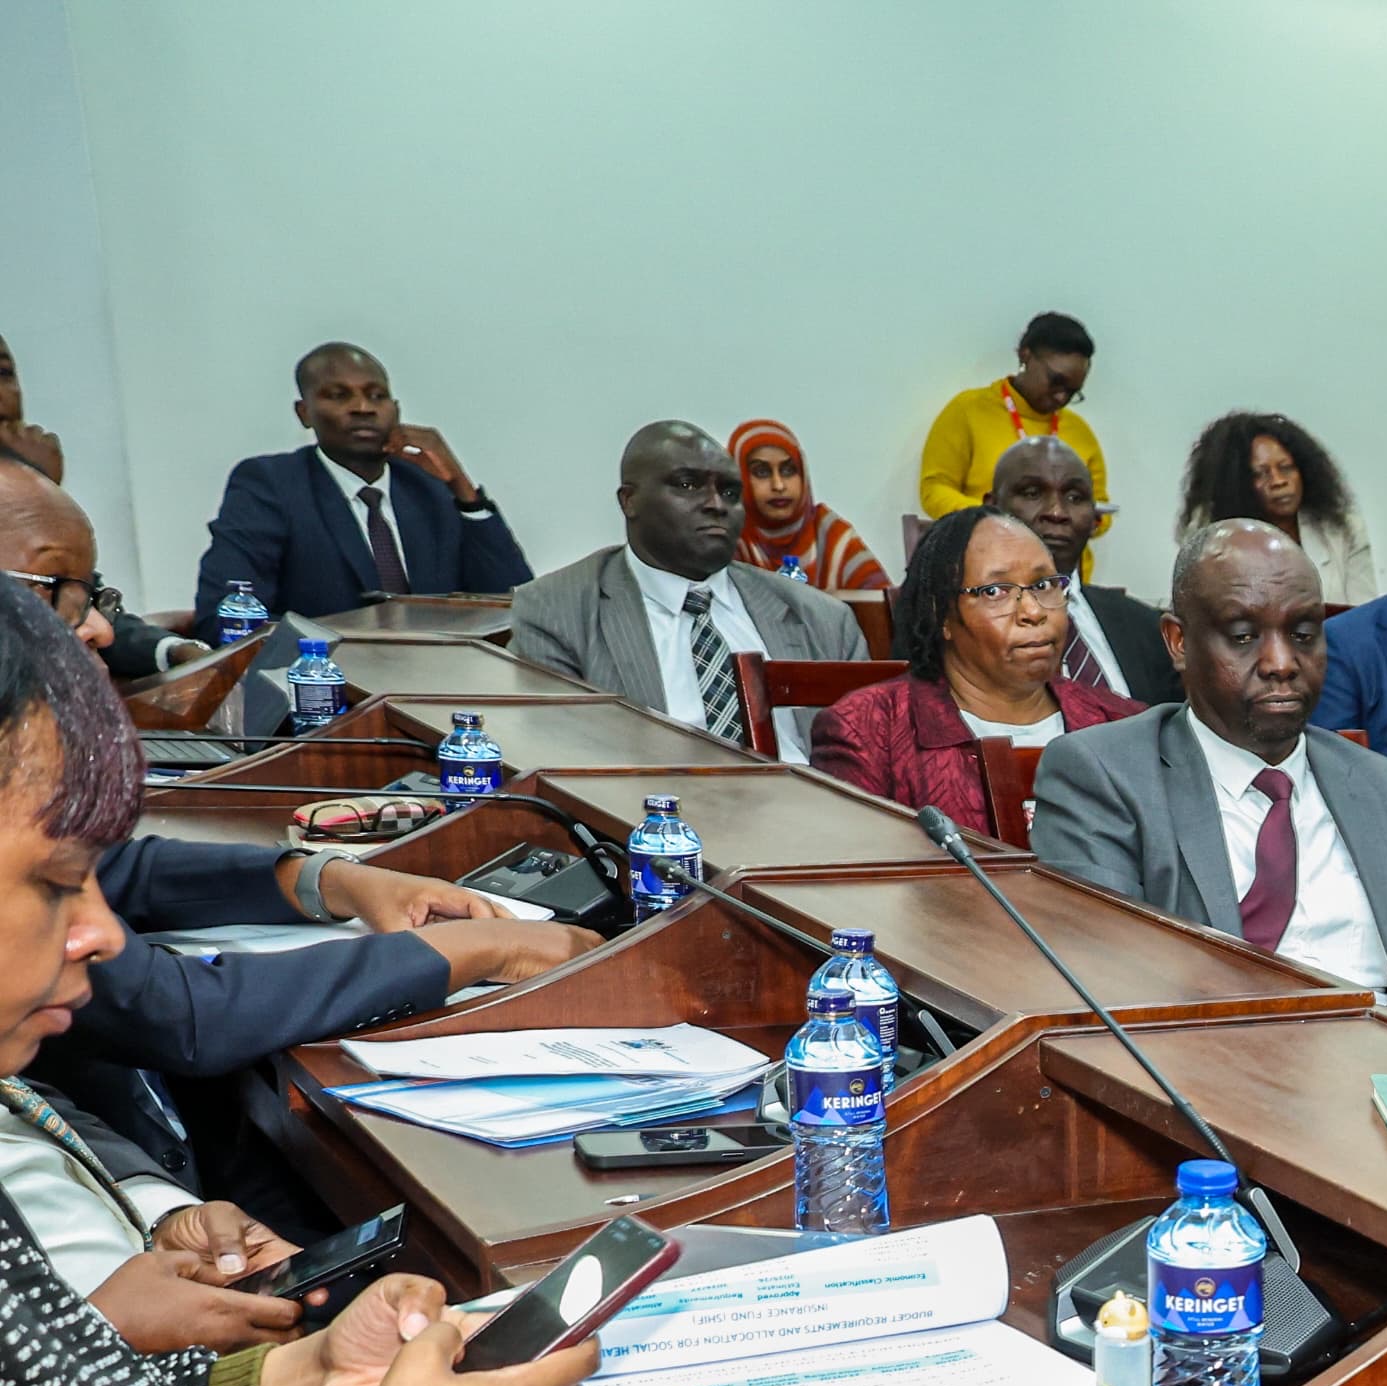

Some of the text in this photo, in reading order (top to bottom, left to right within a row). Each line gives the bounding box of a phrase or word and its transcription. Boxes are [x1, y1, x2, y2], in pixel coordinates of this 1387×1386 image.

[448, 775, 491, 785] KERINGET
[823, 1090, 882, 1110] KERINGET
[824, 1272, 926, 1290] Economic Classification
[678, 1292, 743, 1305] Requirements
[757, 1290, 800, 1302] Approved
[1165, 1294, 1245, 1314] KERINGET
[731, 1309, 762, 1322] FUND
[767, 1303, 828, 1320] INSURANCE
[891, 1310, 934, 1323] BUDGET
[803, 1315, 888, 1334] REQUIREMENTS
[703, 1329, 775, 1345] ALLOCATION
[778, 1326, 801, 1339] AND
[632, 1340, 673, 1354] SOCIAL
[677, 1337, 699, 1348] FOR
